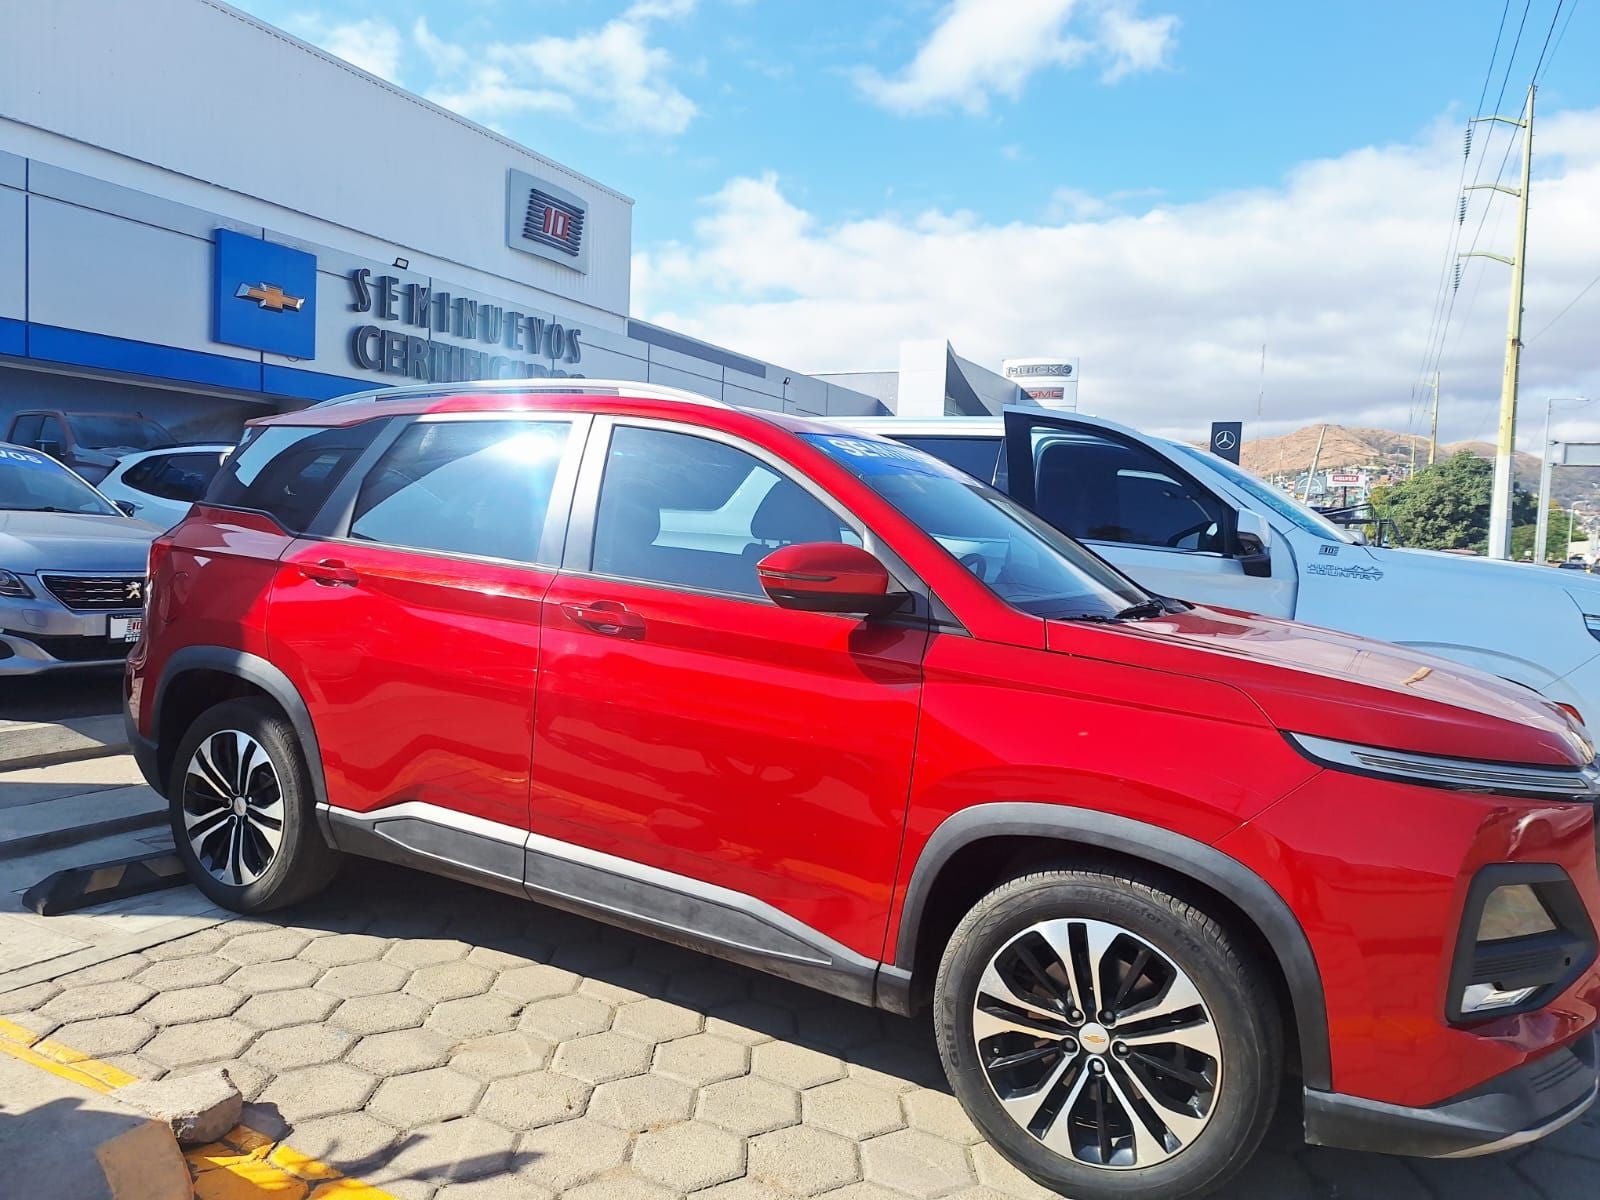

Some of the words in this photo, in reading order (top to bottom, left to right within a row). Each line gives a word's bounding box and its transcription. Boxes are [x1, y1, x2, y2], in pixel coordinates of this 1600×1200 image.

[352, 268, 581, 364] SEMINUEVOS
[352, 325, 586, 383] CERTIFIC
[1029, 390, 1063, 398] GMC
